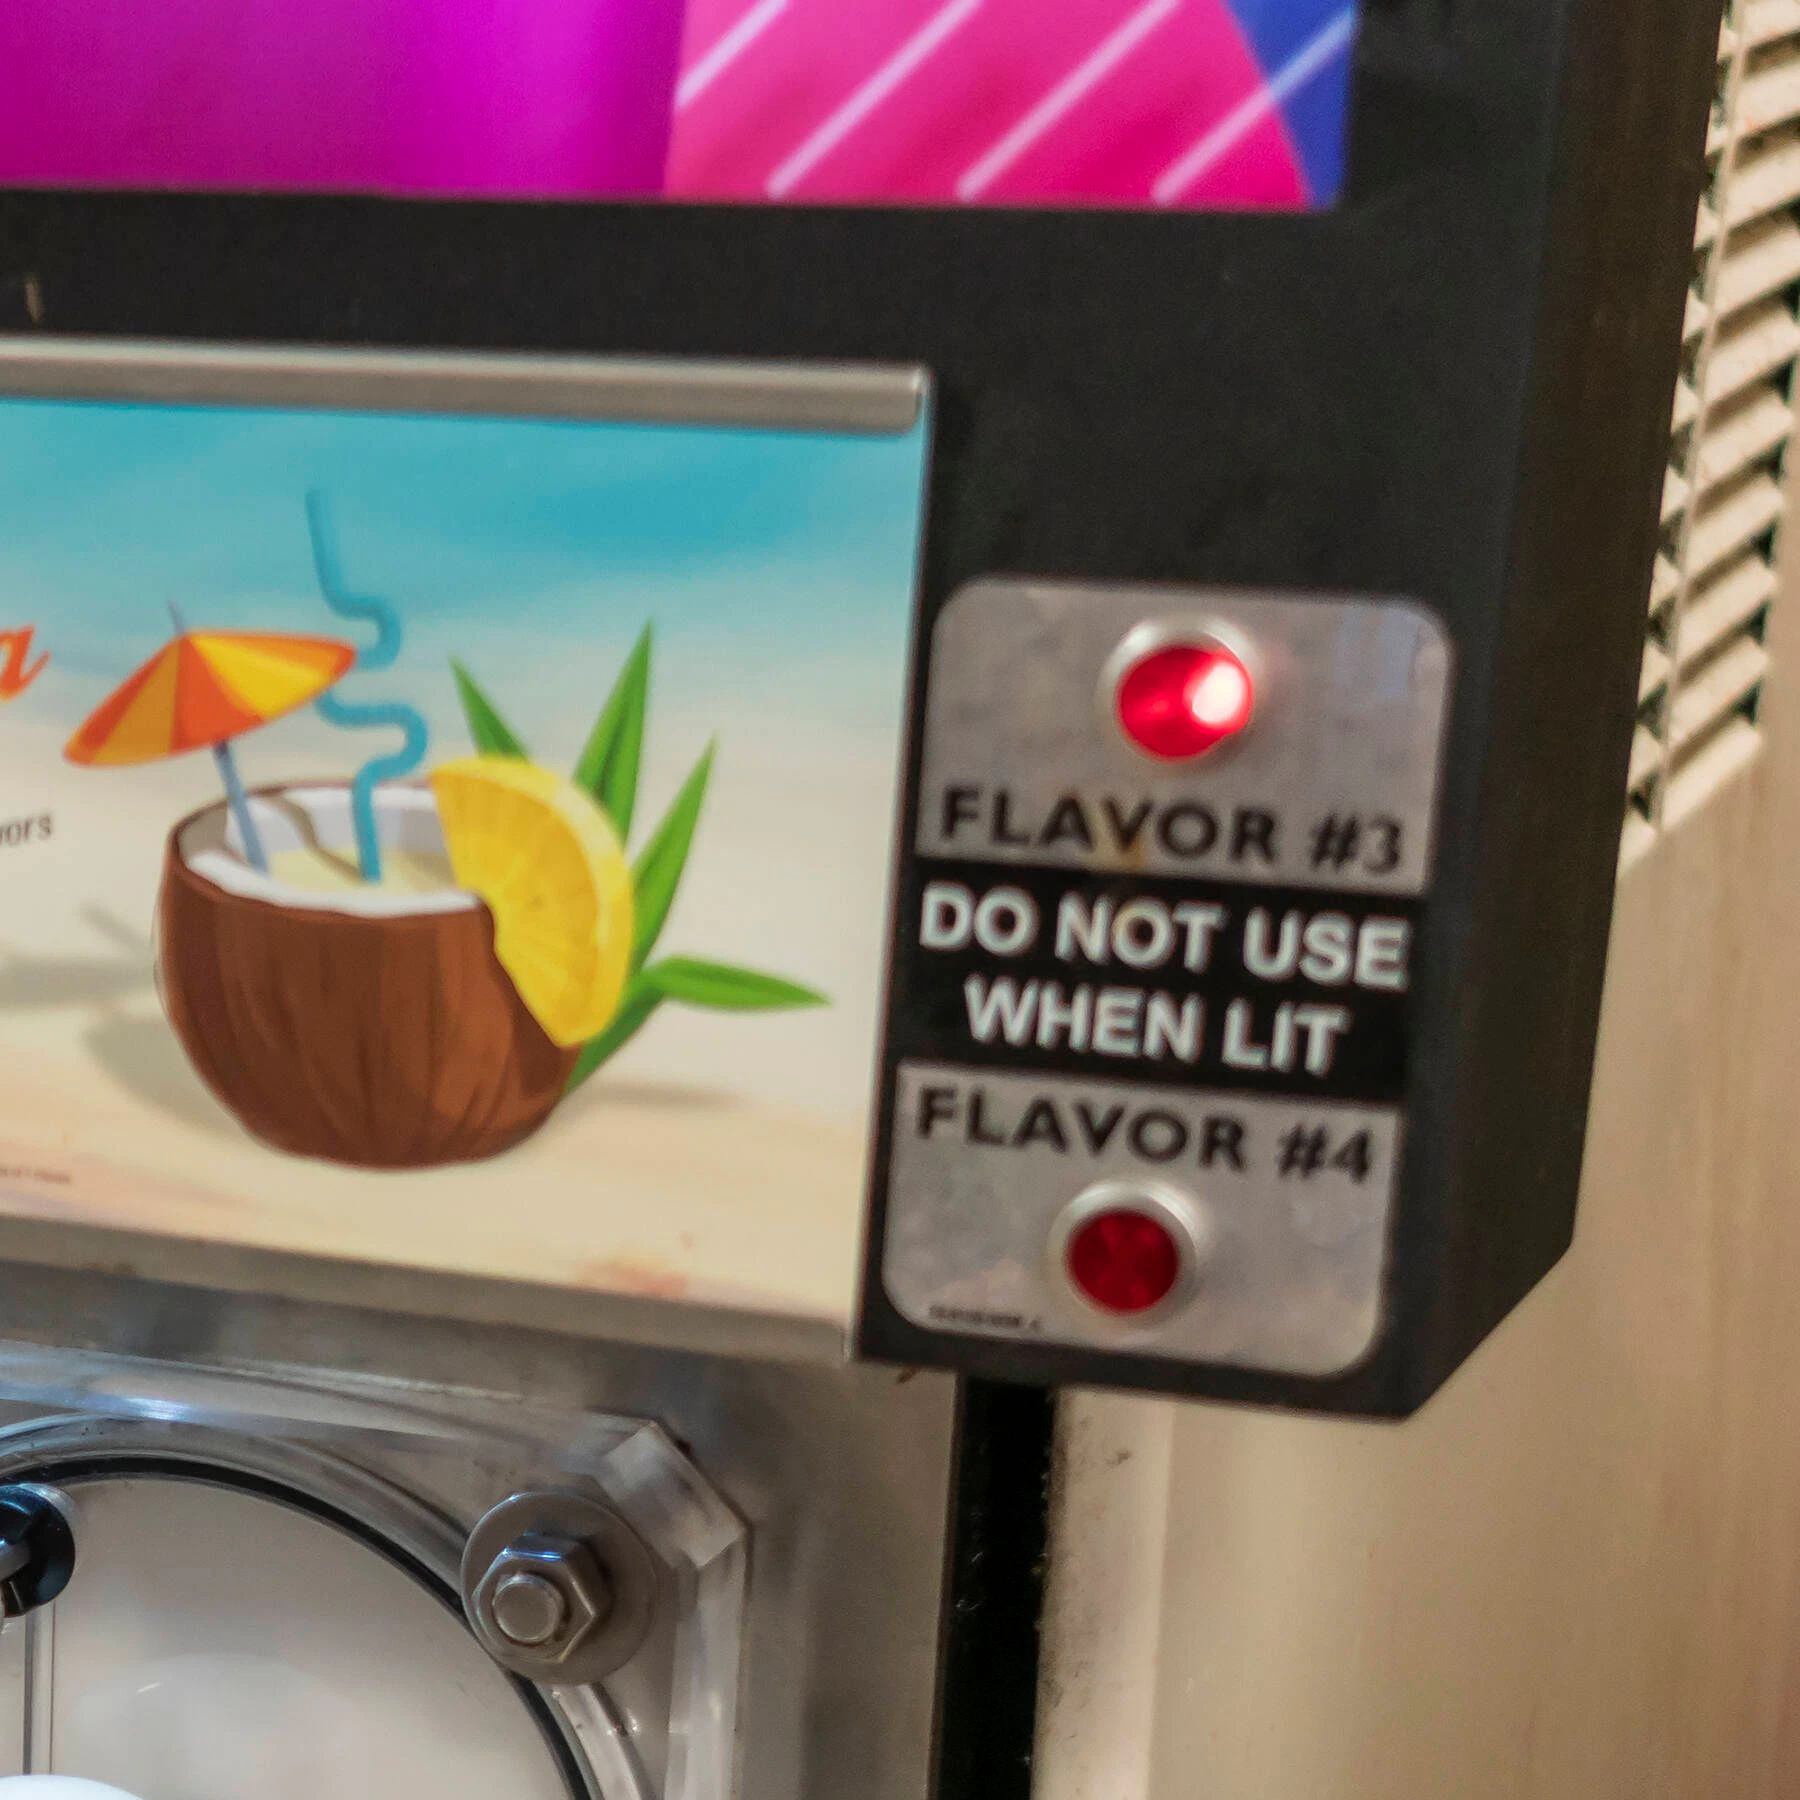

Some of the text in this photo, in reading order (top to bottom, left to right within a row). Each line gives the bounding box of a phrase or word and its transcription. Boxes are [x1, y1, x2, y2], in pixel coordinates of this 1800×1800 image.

[941, 785, 1405, 875] FLAVOR #3
[919, 881, 1410, 993] DO NOT USE
[963, 974, 1352, 1077] WHEN LIT
[916, 1087, 1374, 1184] FLAVOR #4
